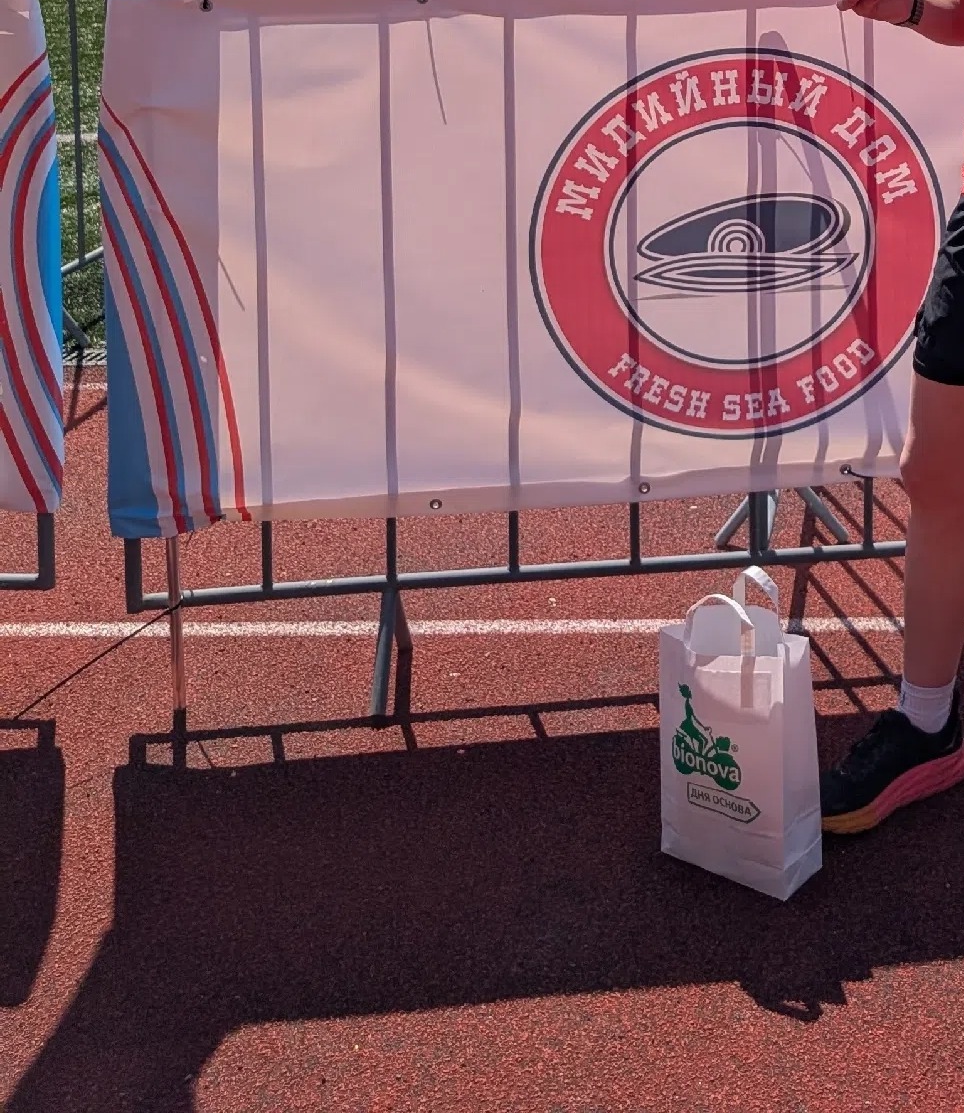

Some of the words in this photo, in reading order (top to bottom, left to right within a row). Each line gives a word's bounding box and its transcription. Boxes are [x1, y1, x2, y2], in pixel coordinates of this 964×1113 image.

[555, 69, 828, 221] МИДИЙНЫЙ
[830, 106, 918, 204] ДОМ
[607, 352, 711, 421] FRESH
[721, 388, 791, 421] SEA
[796, 338, 875, 404] FOOD
[672, 736, 741, 783] bionova
[690, 788, 711, 802] ДНЯ
[712, 794, 752, 817] ОСНОВА
